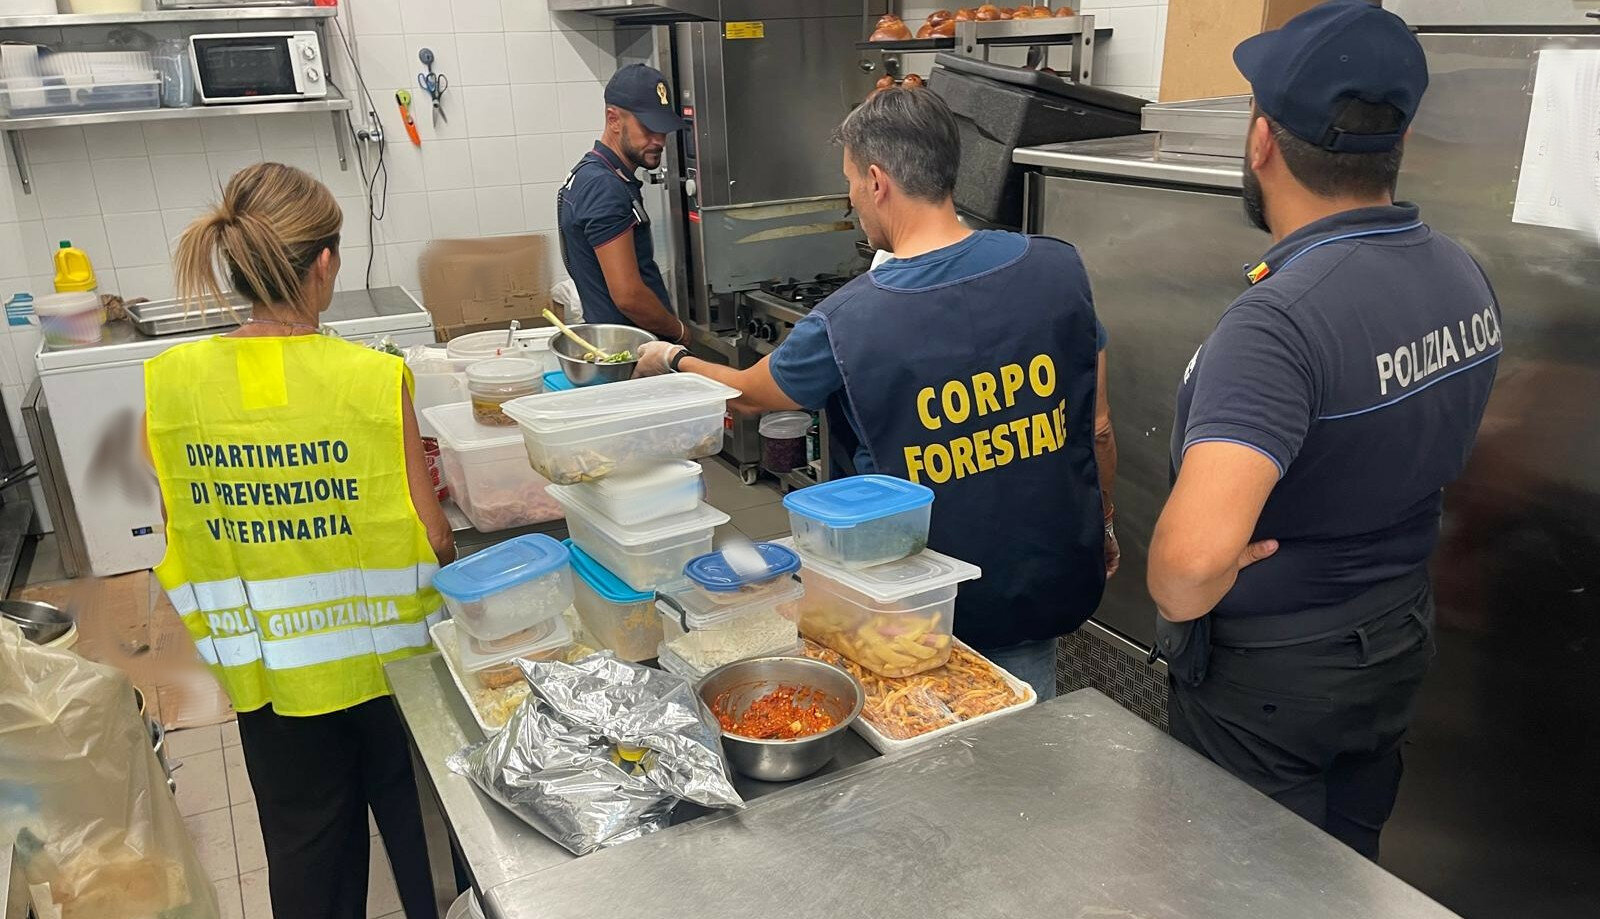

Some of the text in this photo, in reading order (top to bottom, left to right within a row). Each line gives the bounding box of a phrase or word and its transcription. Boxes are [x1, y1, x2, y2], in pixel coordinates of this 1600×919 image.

[1376, 326, 1460, 395] POLIZIA
[916, 353, 1056, 430] CORPO
[186, 440, 349, 468] DIPARTIMENTO
[191, 478, 359, 506] DI PREVENZIONE
[207, 514, 353, 543] VETERINARIA
